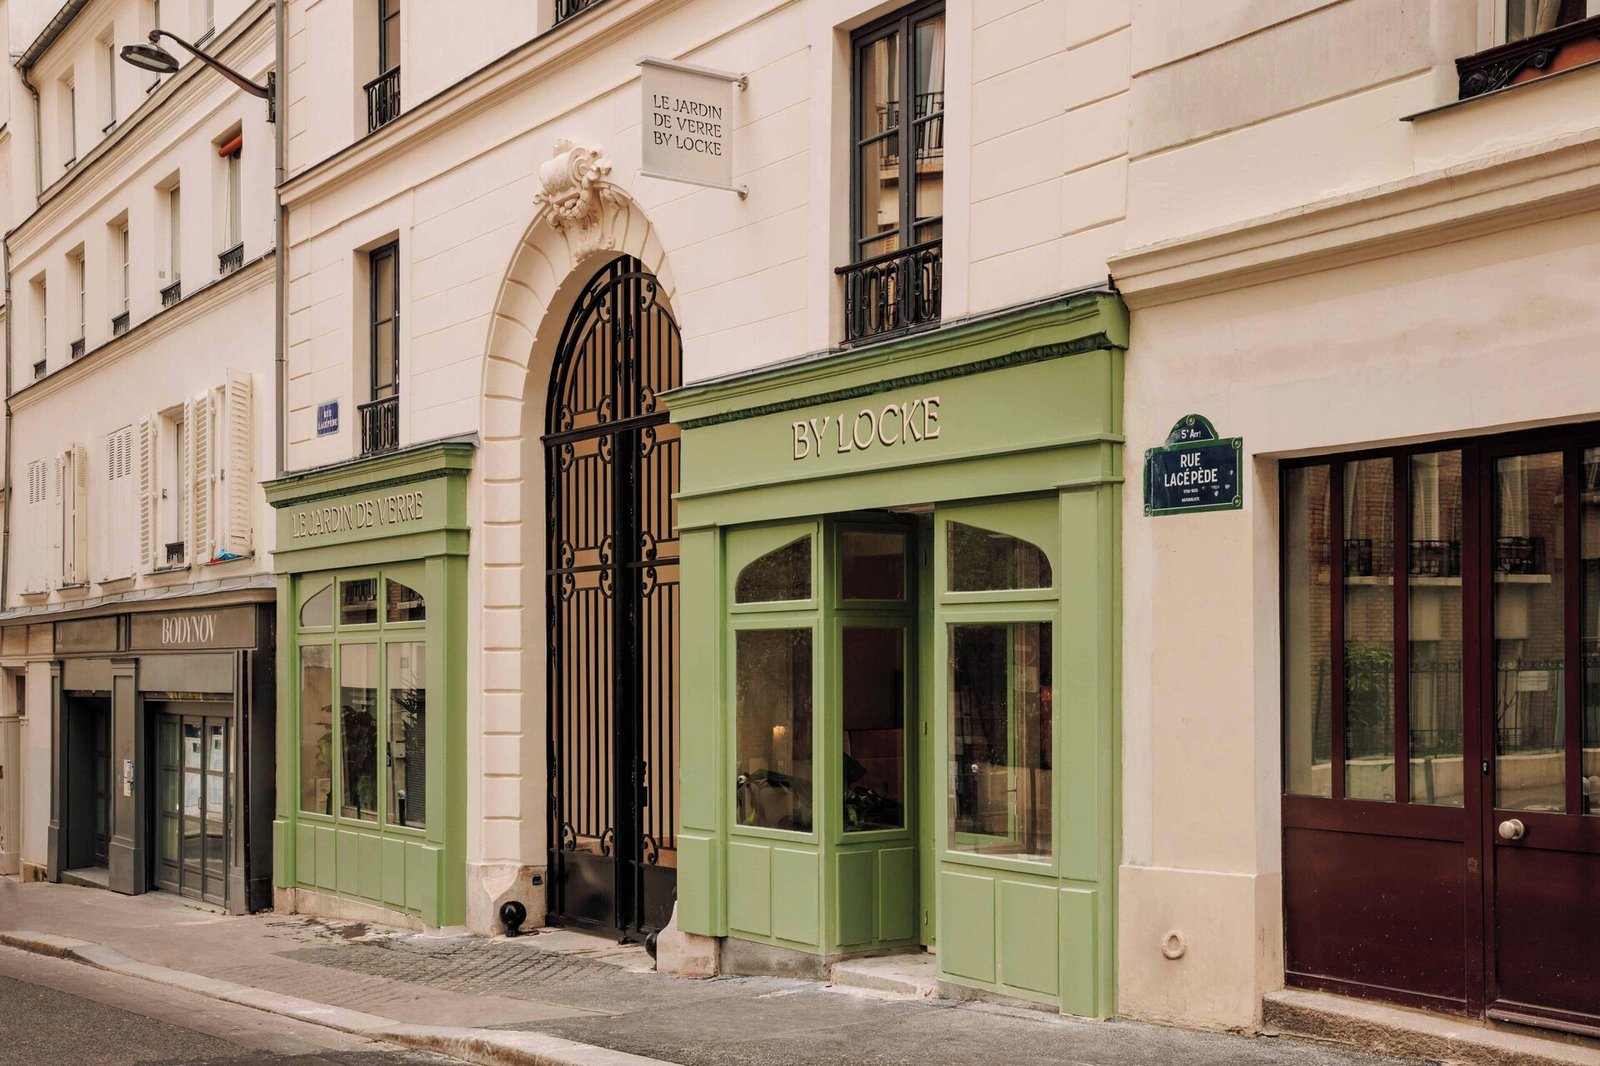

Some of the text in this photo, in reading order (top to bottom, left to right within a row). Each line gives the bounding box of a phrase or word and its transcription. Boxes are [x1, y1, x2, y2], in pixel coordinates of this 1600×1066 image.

[653, 94, 722, 120] LE JARDIN
[653, 112, 722, 138] DE VERRE
[653, 130, 722, 156] BY LOCKE
[792, 396, 941, 460] BY LOCKE
[1180, 452, 1201, 468] RUE
[1164, 467, 1218, 487] LACÉPÈDE
[292, 491, 423, 538] LE JARDIN DE VERRE
[162, 614, 217, 644] BODYNOV
